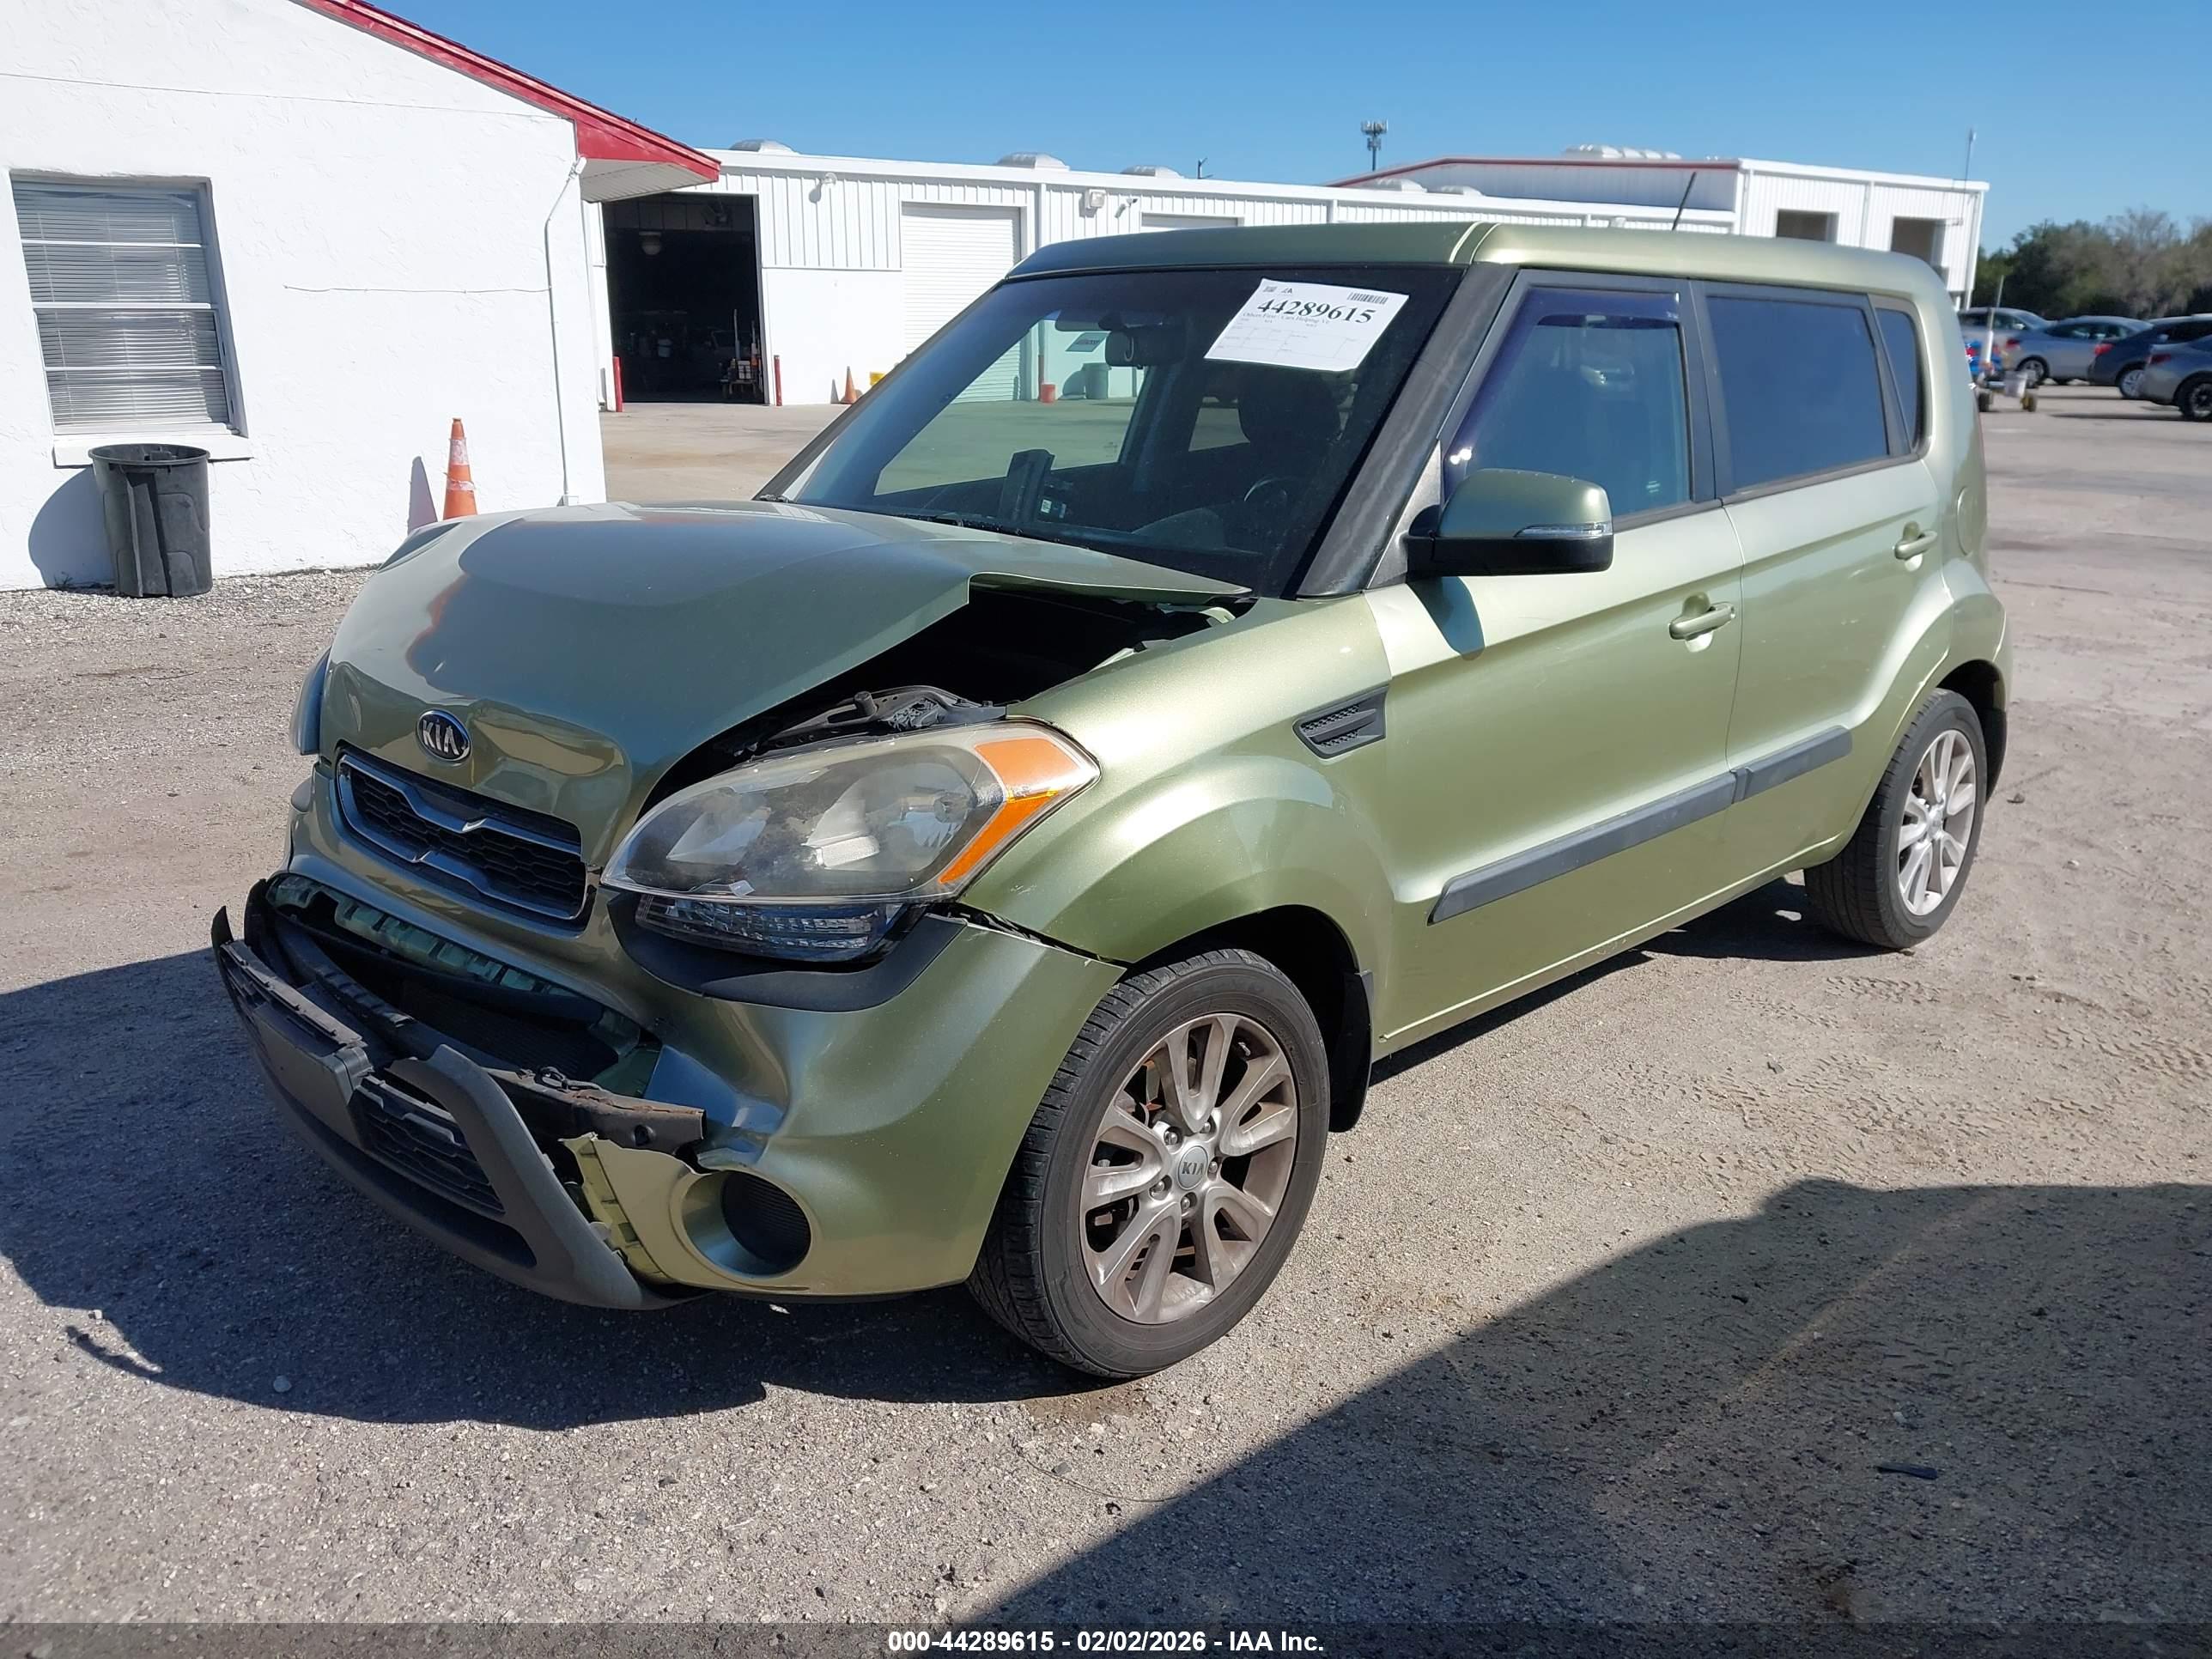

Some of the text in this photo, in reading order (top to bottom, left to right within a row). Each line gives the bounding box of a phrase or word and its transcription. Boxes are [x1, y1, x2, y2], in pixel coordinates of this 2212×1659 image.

[1256, 298, 1377, 324] 44289615
[422, 719, 460, 756] KIA
[1181, 1161, 1206, 1176] KIA
